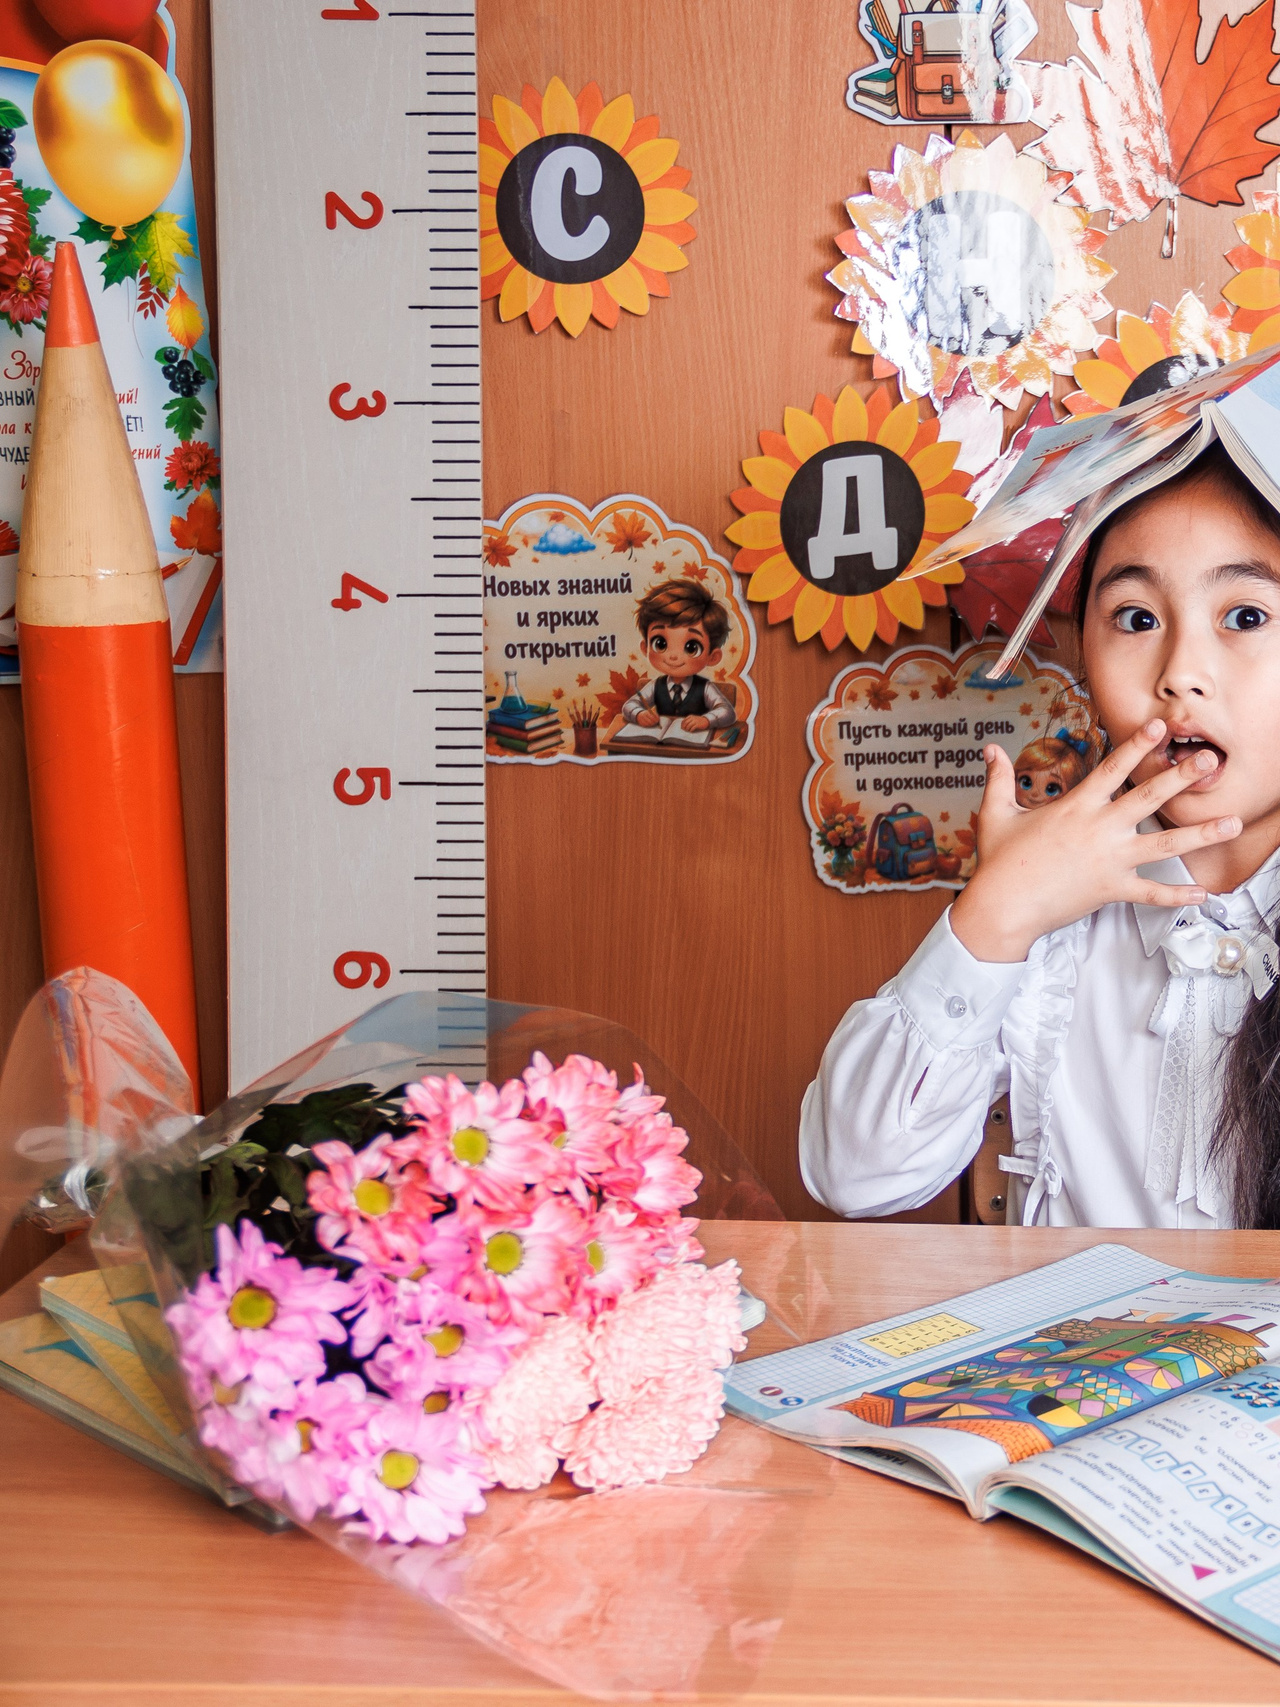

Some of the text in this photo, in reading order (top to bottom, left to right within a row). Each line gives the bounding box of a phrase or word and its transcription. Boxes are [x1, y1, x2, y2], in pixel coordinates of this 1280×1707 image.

[324, 191, 384, 230] 2
[531, 146, 610, 261] С
[926, 212, 1022, 336] Н
[328, 382, 387, 421] 3
[807, 455, 898, 580] Д
[330, 572, 389, 612] 4
[484, 572, 633, 597] Новых знаний
[516, 610, 599, 634] и ярких
[504, 634, 617, 665] открытий!
[838, 718, 1015, 745] Пусть каждый день
[844, 748, 985, 771] приносит радос
[333, 767, 391, 806] 5
[856, 772, 985, 796] и вдохновение
[333, 951, 391, 989] 6
[830, 1353, 857, 1368] КАКОЕ
